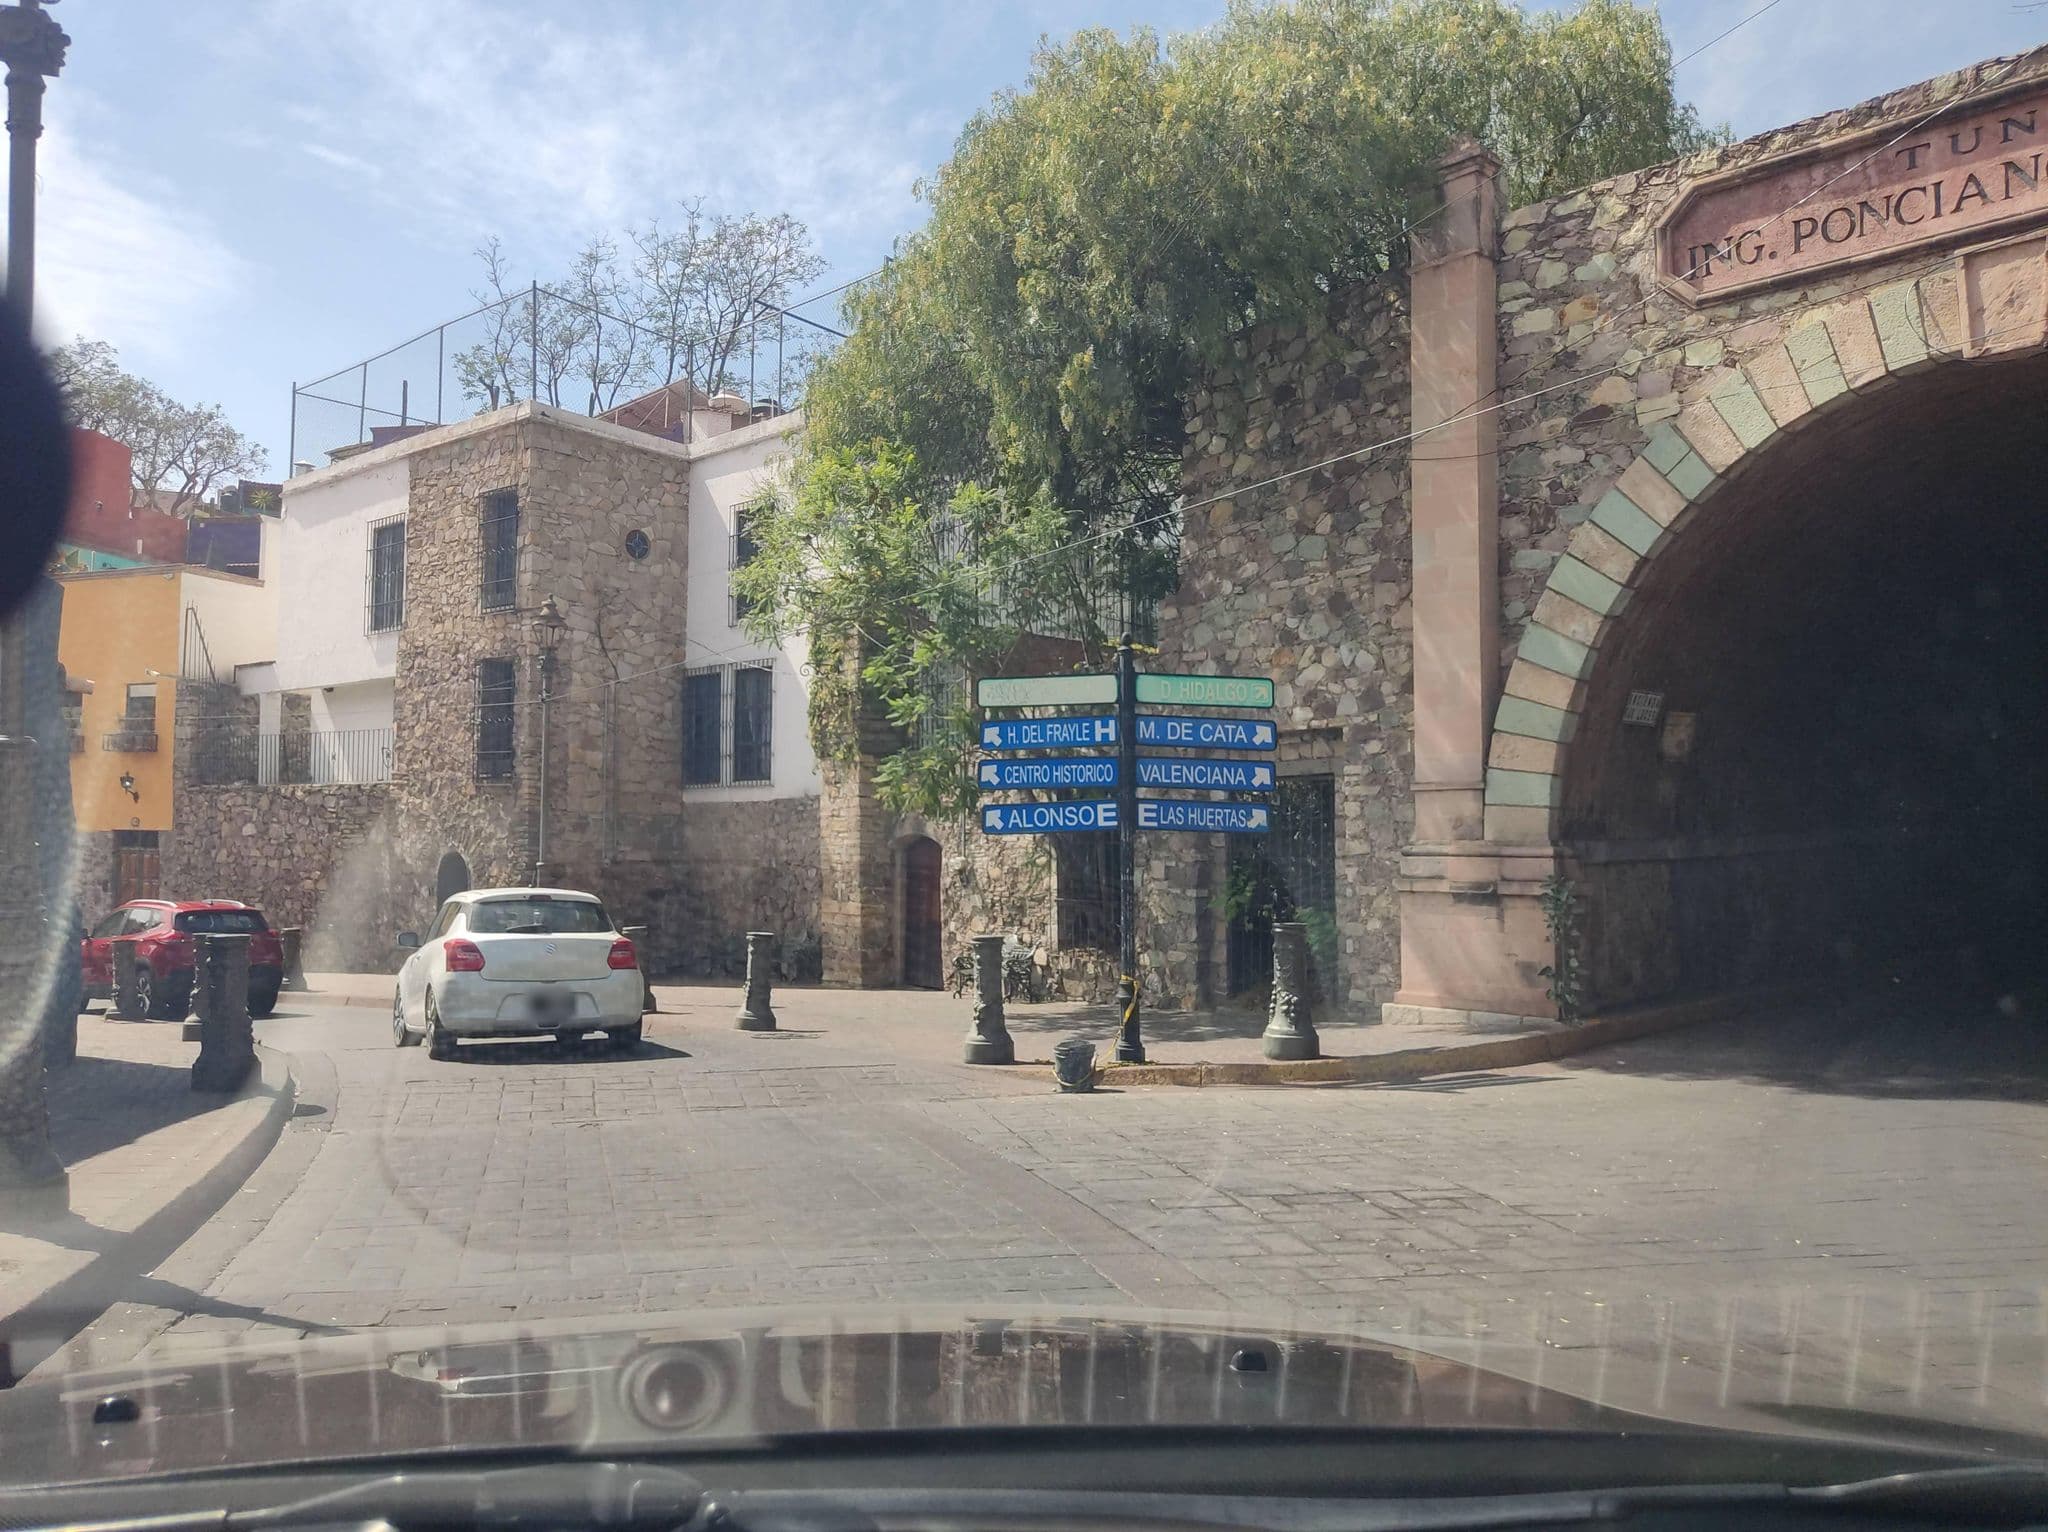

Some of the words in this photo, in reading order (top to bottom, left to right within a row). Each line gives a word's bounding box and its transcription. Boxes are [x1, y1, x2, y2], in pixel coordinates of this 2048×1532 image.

[1687, 229, 1778, 281] ING.
[1792, 152, 2048, 255] PONCIAN
[1181, 682, 1247, 702] HIDALGO
[1007, 727, 1019, 743] H.
[1023, 725, 1044, 742] DEL
[1046, 723, 1090, 741] FRAYLE
[1095, 720, 1115, 741] H
[1139, 721, 1160, 740] M.
[1167, 723, 1193, 740] DE
[1199, 724, 1248, 743] CATA
[1004, 766, 1051, 784] CENTRO
[1053, 764, 1114, 783] HISTORICO
[1140, 764, 1247, 785] VALENCIANA
[1009, 807, 1094, 827] ALONSO
[1097, 803, 1118, 826] E
[1138, 803, 1158, 827] E
[1160, 806, 1185, 825] LAS
[1188, 807, 1247, 828] HUERTAS
